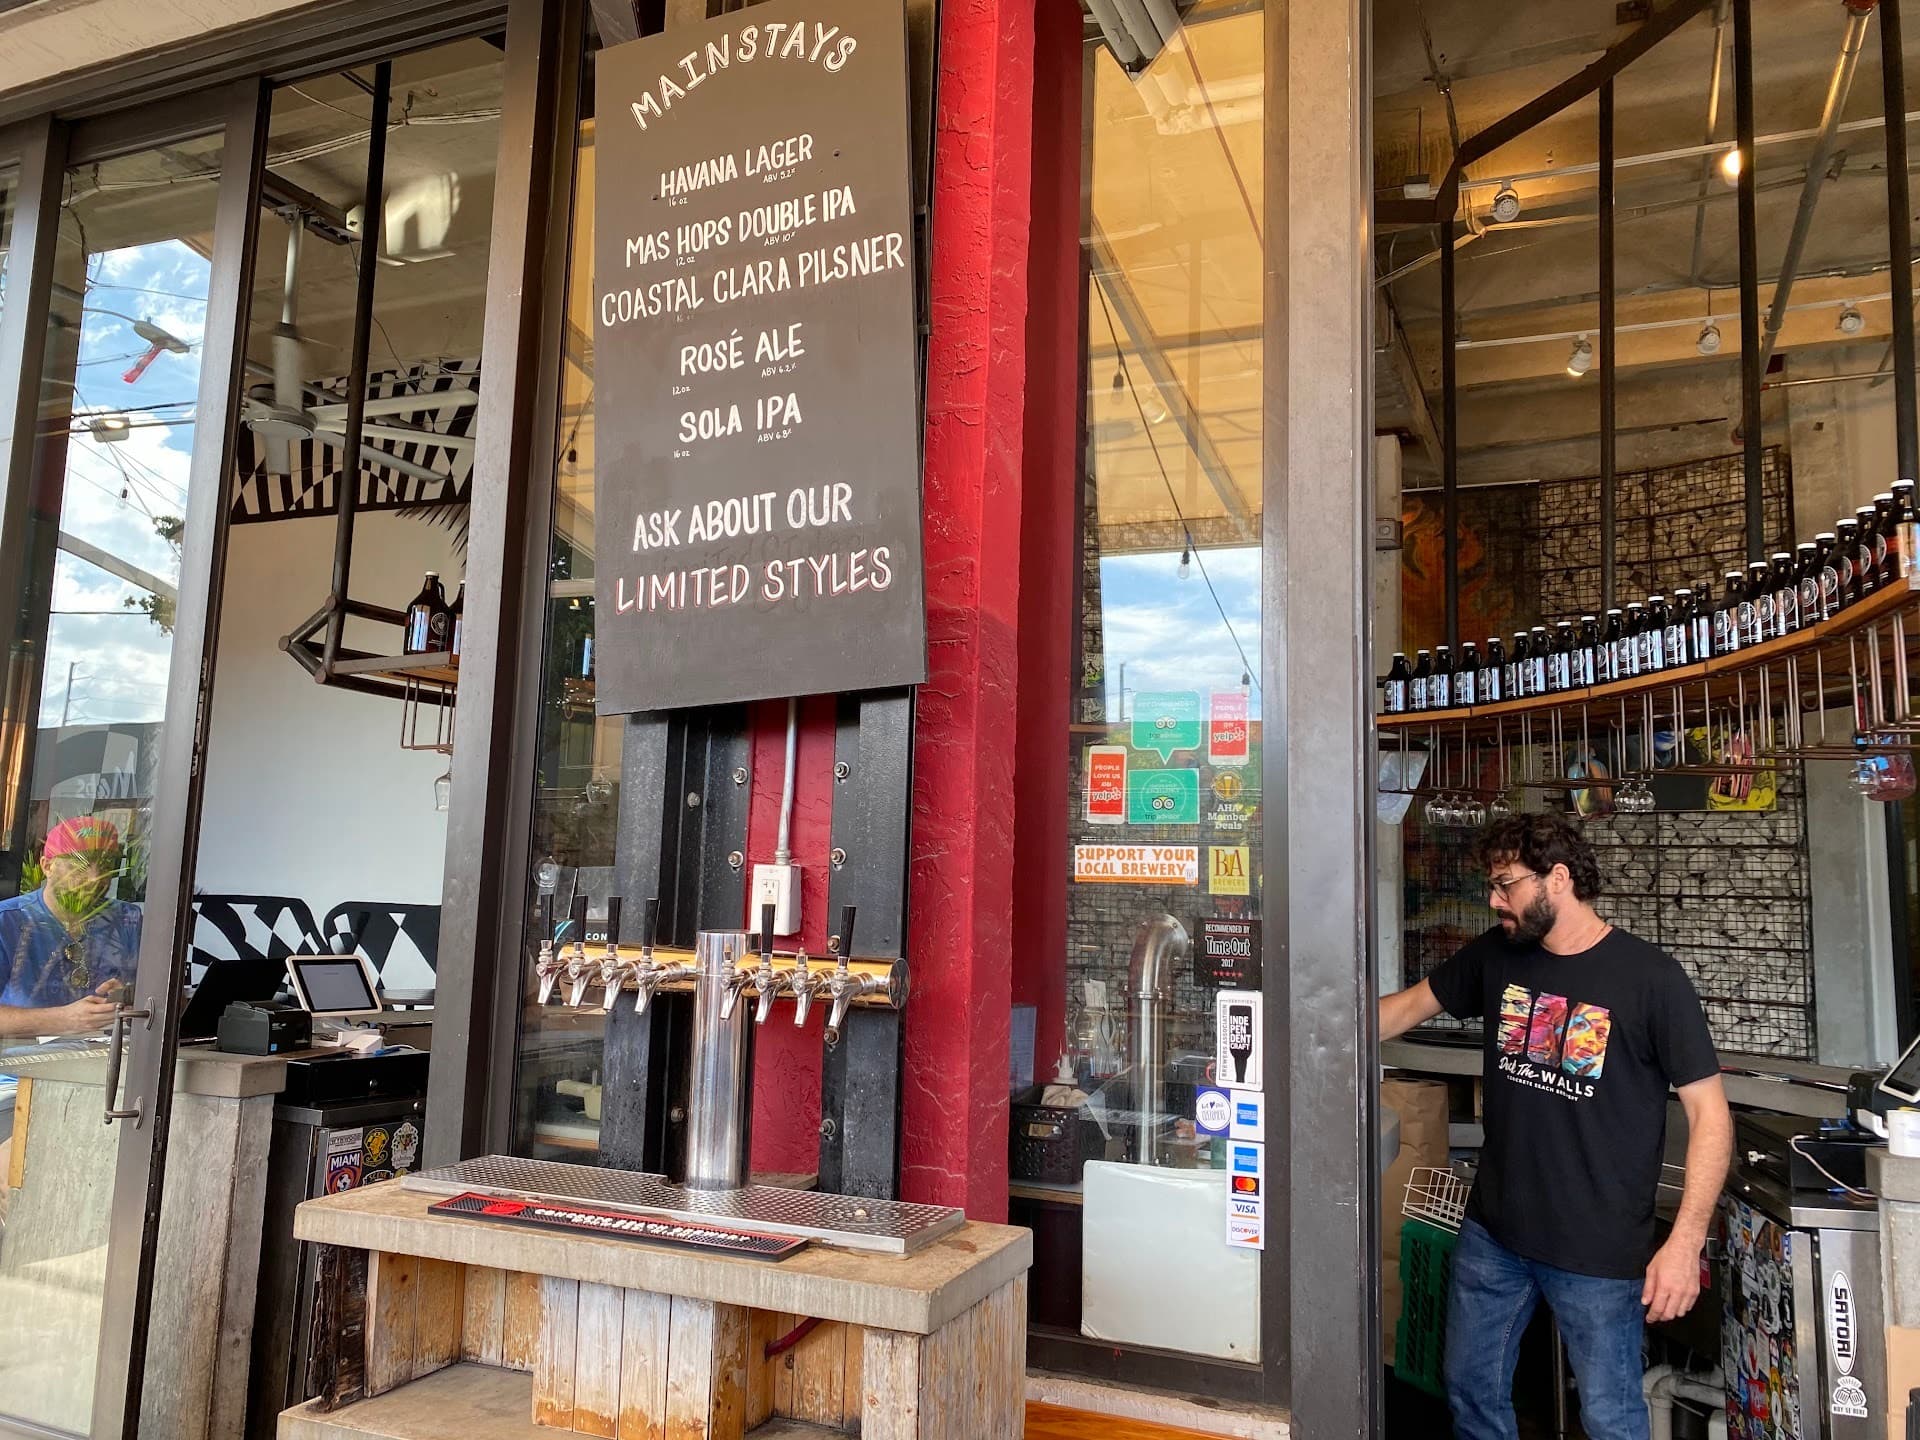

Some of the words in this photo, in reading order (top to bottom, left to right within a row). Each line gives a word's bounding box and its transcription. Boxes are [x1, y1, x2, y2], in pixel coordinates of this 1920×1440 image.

[630, 21, 857, 130] MAINSTAYS
[661, 154, 738, 198] HAVANA
[745, 133, 813, 177] LAGER
[763, 173, 778, 183] ABV
[669, 197, 677, 207] 16
[625, 231, 670, 268] MAS
[677, 216, 732, 255] HOPS
[739, 194, 816, 242] DOUBLE
[823, 185, 856, 222] IPA
[764, 235, 780, 246] ABV
[676, 256, 686, 267] 12
[601, 275, 704, 327] COASTAL
[712, 256, 791, 304] CLARA
[799, 232, 905, 287] PILSNER
[680, 328, 744, 376] ROSÉ
[755, 322, 805, 363] ALE
[761, 367, 776, 378] ABV
[679, 404, 742, 443] SOLA
[757, 392, 802, 430] IPA
[757, 432, 773, 443] ABV
[633, 508, 682, 551] ASK
[688, 492, 777, 544] ABOUT
[786, 482, 853, 529] OUR
[615, 563, 750, 615] LIMITED
[761, 546, 892, 602] STYLES
[1213, 731, 1235, 743] yelp
[1092, 790, 1112, 802] yelp
[1208, 812, 1248, 822] Member
[1215, 821, 1242, 830] Deals
[1077, 848, 1146, 861] SUPPORT
[1152, 848, 1196, 862] YOUR
[1077, 862, 1116, 875] LOCAL
[1121, 863, 1186, 876] BREWERY
[1205, 924, 1242, 933] RECOMMENDED
[1243, 926, 1251, 934] BY
[1221, 959, 1234, 967] 2017
[1230, 1016, 1249, 1025] INDE
[1230, 1025, 1246, 1033] PEN
[1230, 1034, 1251, 1043] DENT
[1506, 1074, 1533, 1087] CONCRETE
[1534, 1083, 1554, 1093] BEACH
[1541, 1070, 1595, 1097] WALLS
[331, 1153, 360, 1171] MIAMI
[1235, 1204, 1257, 1214] VISA
[1231, 1226, 1258, 1235] DISCOVER
[1834, 1287, 1851, 1358] SATORI
